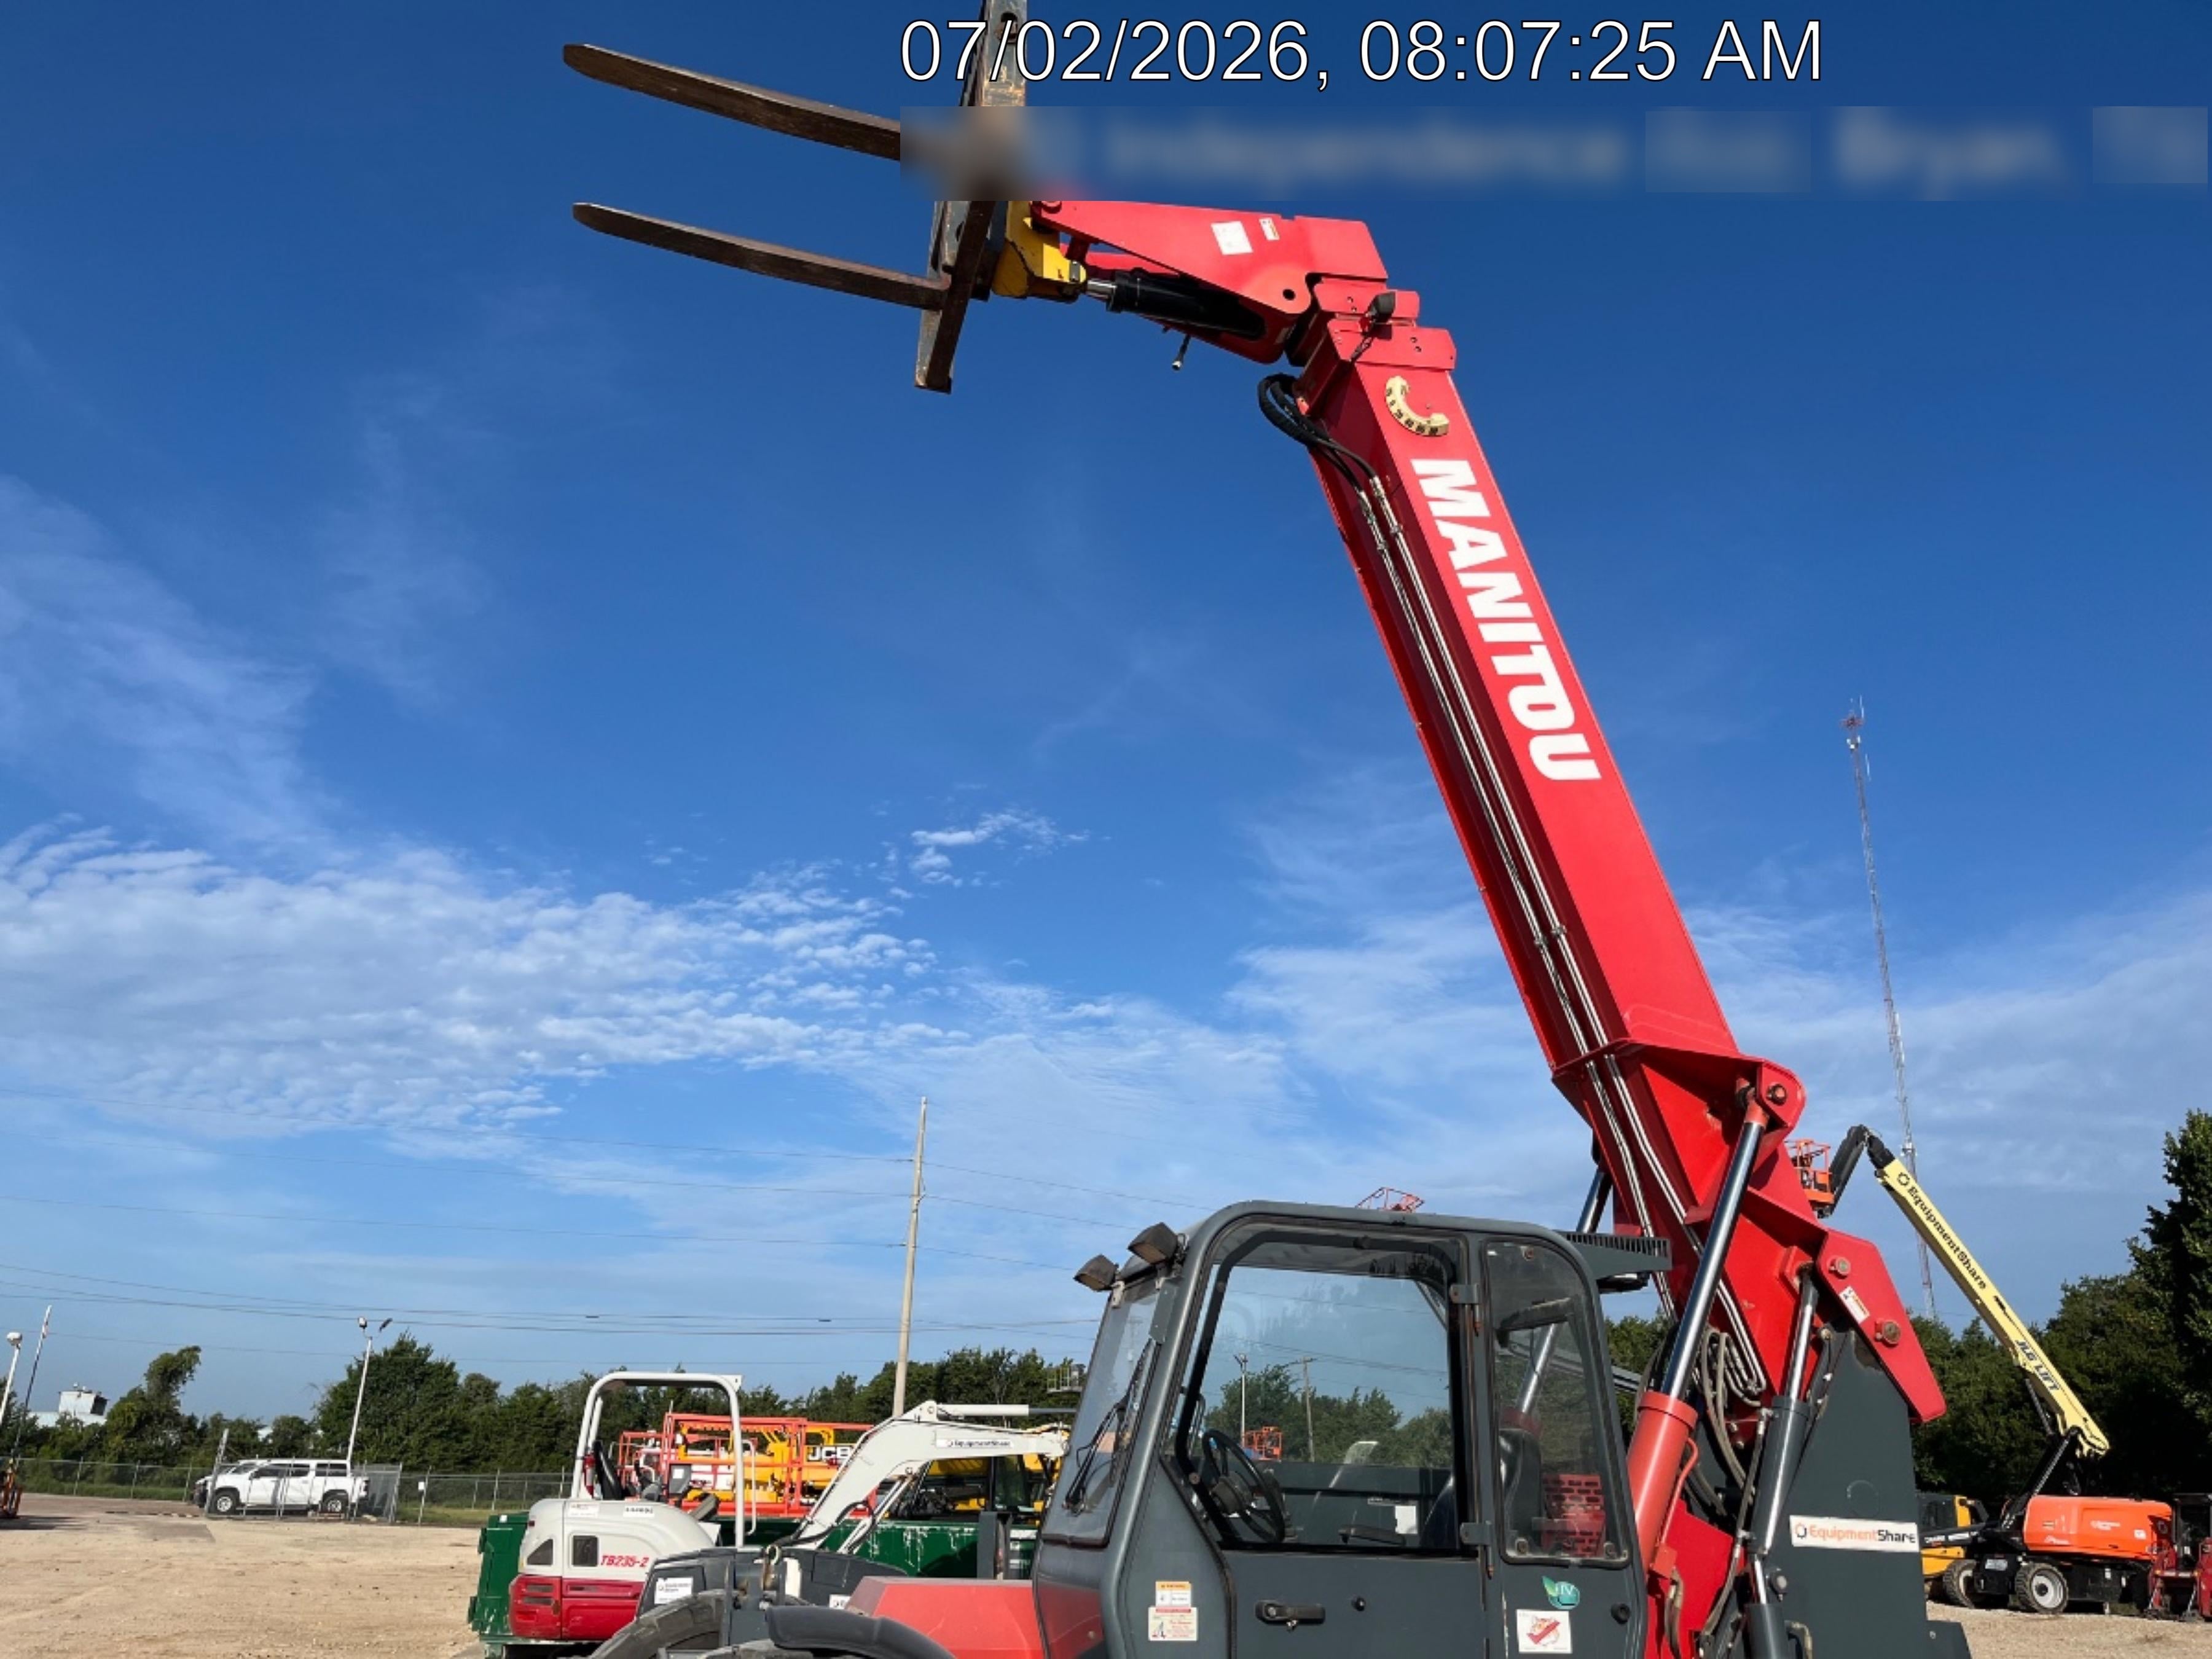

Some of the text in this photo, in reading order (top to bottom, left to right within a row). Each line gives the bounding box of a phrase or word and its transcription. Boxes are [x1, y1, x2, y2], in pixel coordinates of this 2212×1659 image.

[1411, 459, 1601, 780] MANITOU
[1908, 1186, 1986, 1289] EquipmentShare
[807, 1446, 852, 1461] JCB
[1809, 1525, 1916, 1543] EquipmentShare
